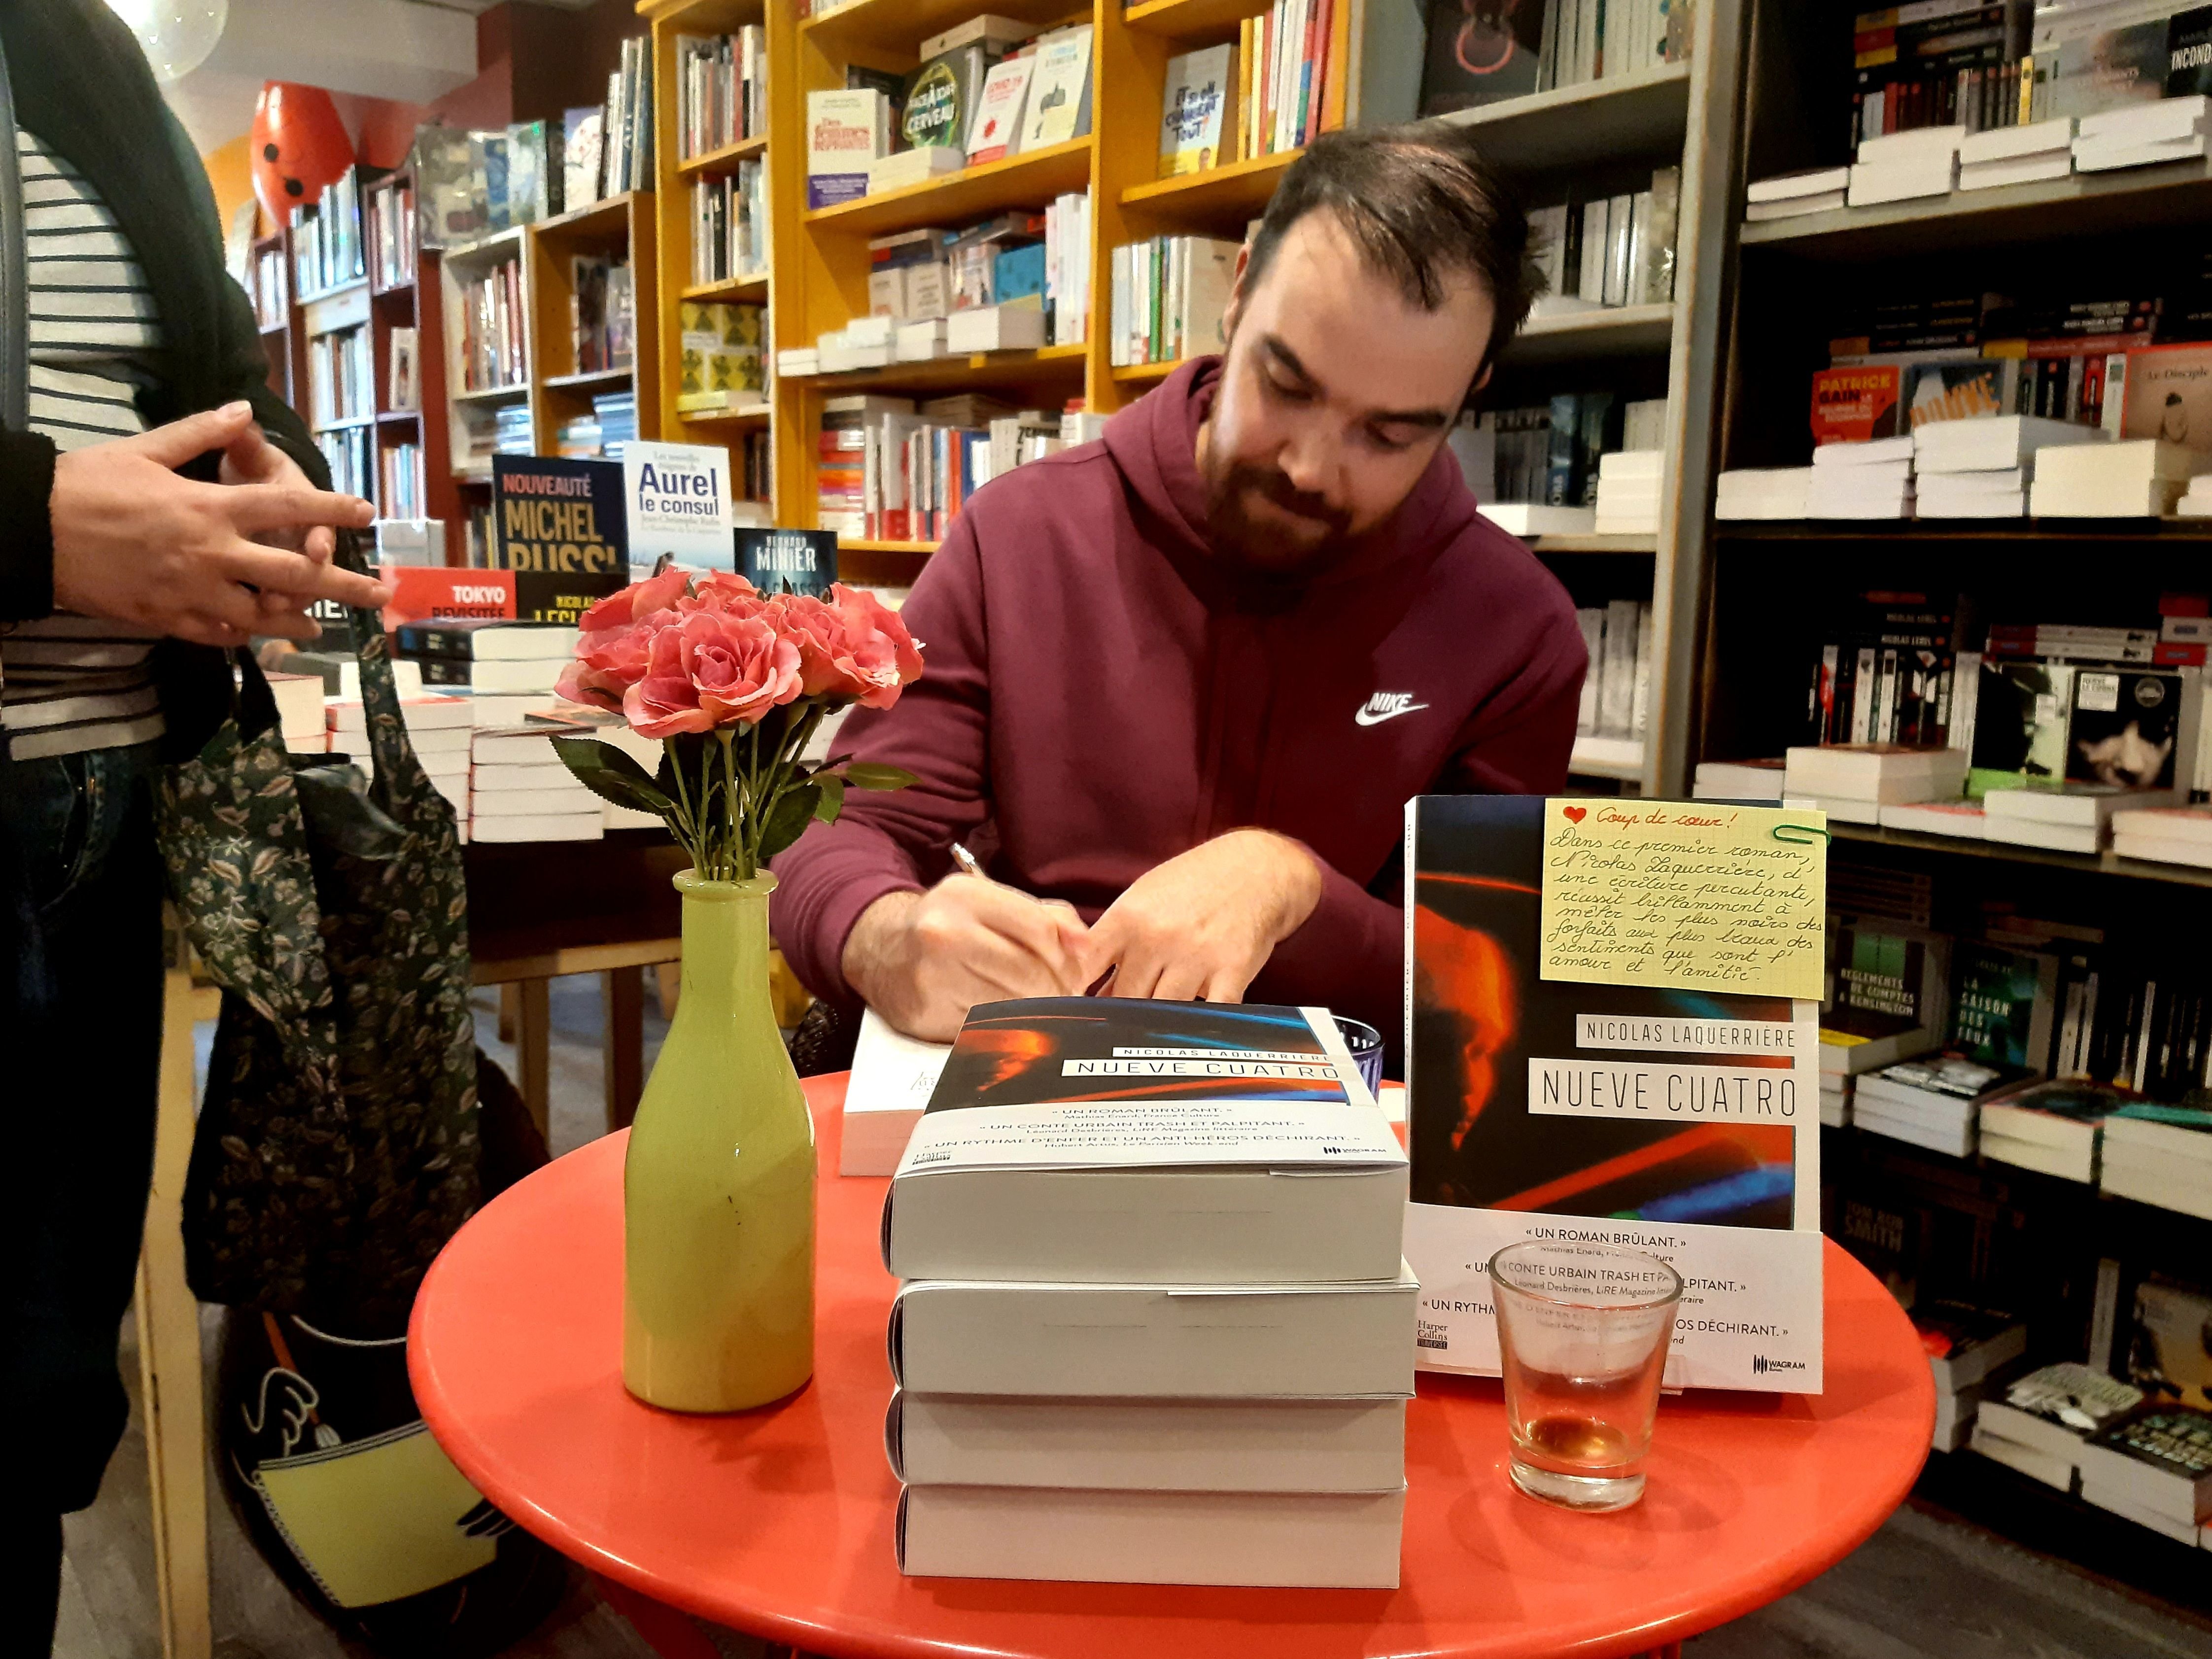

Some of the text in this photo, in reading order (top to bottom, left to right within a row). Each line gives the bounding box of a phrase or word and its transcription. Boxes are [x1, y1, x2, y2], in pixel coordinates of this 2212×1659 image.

[2172, 43, 2212, 70] INCOND
[502, 473, 592, 497] NOUVEAUTÉ
[639, 462, 718, 497] Aurel
[639, 493, 719, 516] le consul
[505, 498, 604, 542] MICHEL
[756, 546, 817, 572] MINIER
[452, 585, 506, 604] TOKYO
[1366, 692, 1413, 712] NIKE
[1597, 807, 1640, 830] Coup
[1645, 808, 1667, 824] de
[1550, 827, 1811, 866] Dans ce premier roman,
[1551, 850, 1636, 871] Nicolas
[1554, 873, 1598, 884] une
[1609, 874, 1689, 891] écriture
[1554, 888, 1626, 905] réussit
[1775, 901, 1793, 914] à
[1555, 905, 1823, 931] mêler les plus noirs des
[1547, 918, 1814, 949] forfaits aux plus beaux des
[1549, 955, 1611, 969] amour
[1625, 957, 1646, 972] et
[1552, 939, 1655, 955] sentiments
[1662, 950, 1696, 965] que
[1710, 948, 1760, 962] sont
[1587, 1021, 1796, 1047] NICOLAS LAQUERRIÈRE
[1077, 1062, 1339, 1079] NUEVE CUATRO
[1543, 1069, 1796, 1117] NUEVE CUATRO
[1535, 1227, 1555, 1239] UN
[1559, 1230, 1609, 1244] ROMAN
[1613, 1232, 1678, 1248] BRÛLANT.
[1508, 1262, 1546, 1276] CONTE
[1549, 1267, 1596, 1280] URBAIN
[1599, 1270, 1639, 1281] TRASH
[1642, 1272, 1656, 1282] ET
[1619, 1286, 1656, 1299] Magazine
[1418, 1319, 1448, 1333] Harper
[1431, 1299, 1451, 1311] UN
[1698, 1318, 1780, 1337] DÉCHIRANT.
[1417, 1329, 1448, 1341] Collins
[1768, 1360, 1805, 1370] WAGRAM
